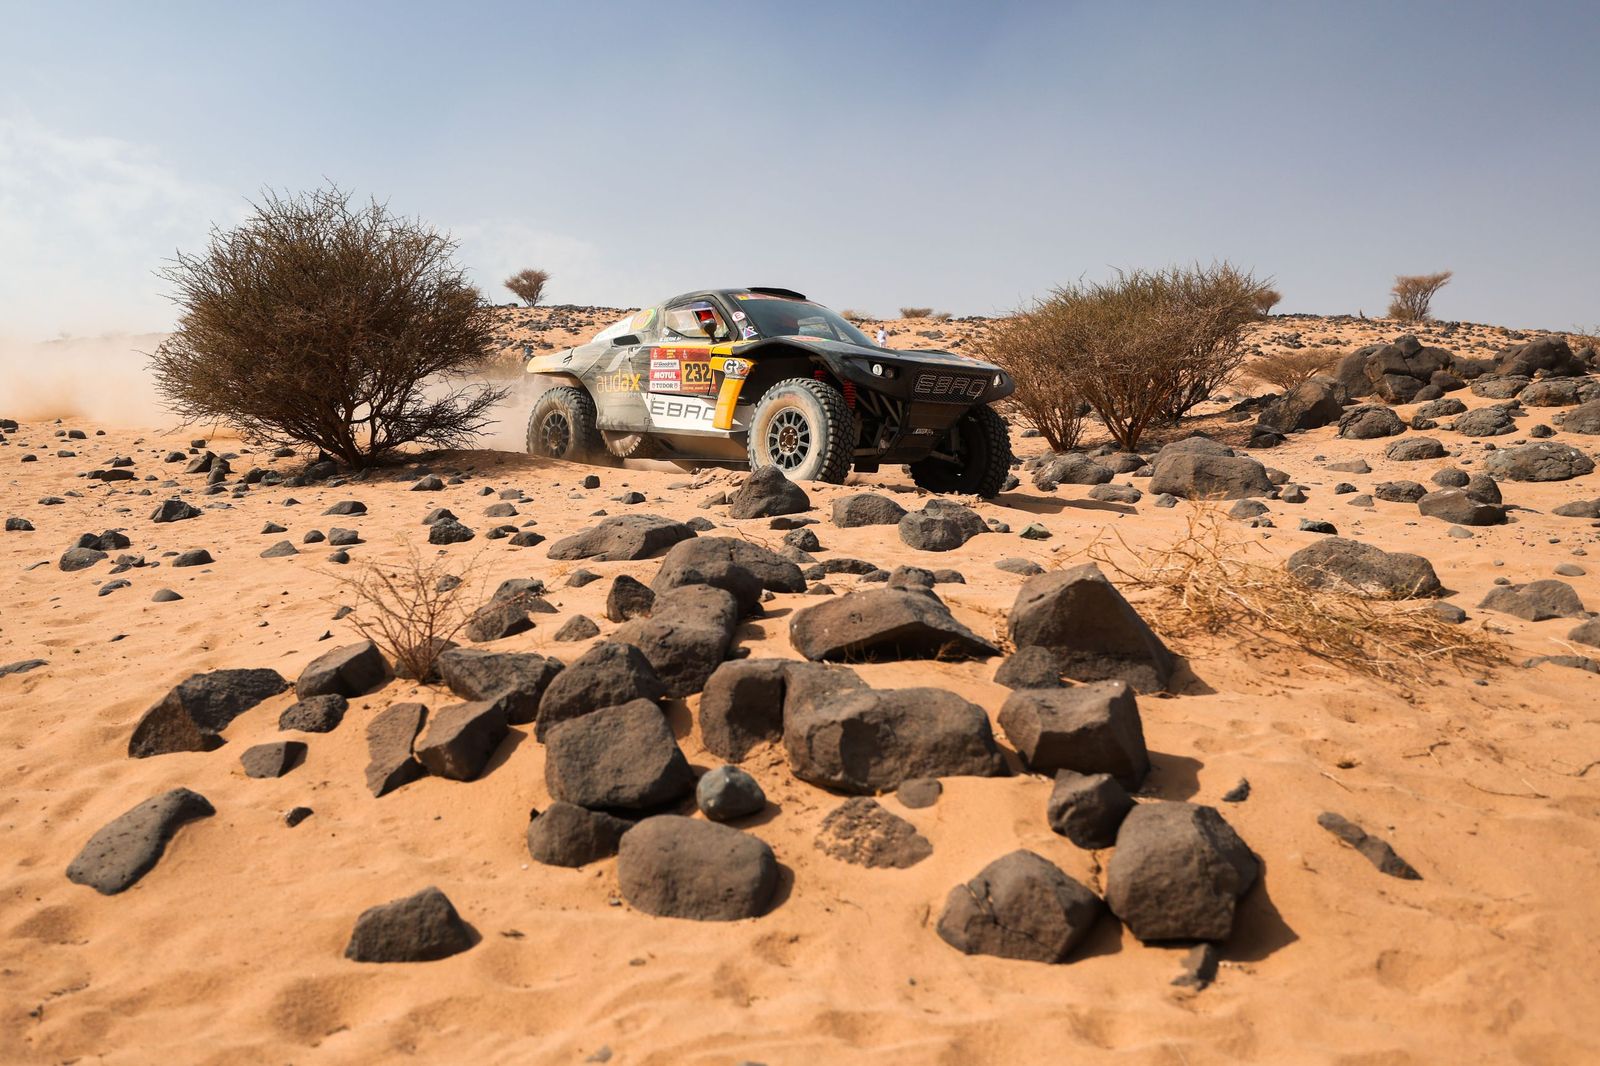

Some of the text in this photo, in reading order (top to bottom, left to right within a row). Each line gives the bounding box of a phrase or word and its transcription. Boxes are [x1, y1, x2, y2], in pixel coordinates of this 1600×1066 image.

[596, 368, 641, 393] audax
[653, 371, 676, 379] MOTUL
[684, 363, 711, 382] 232
